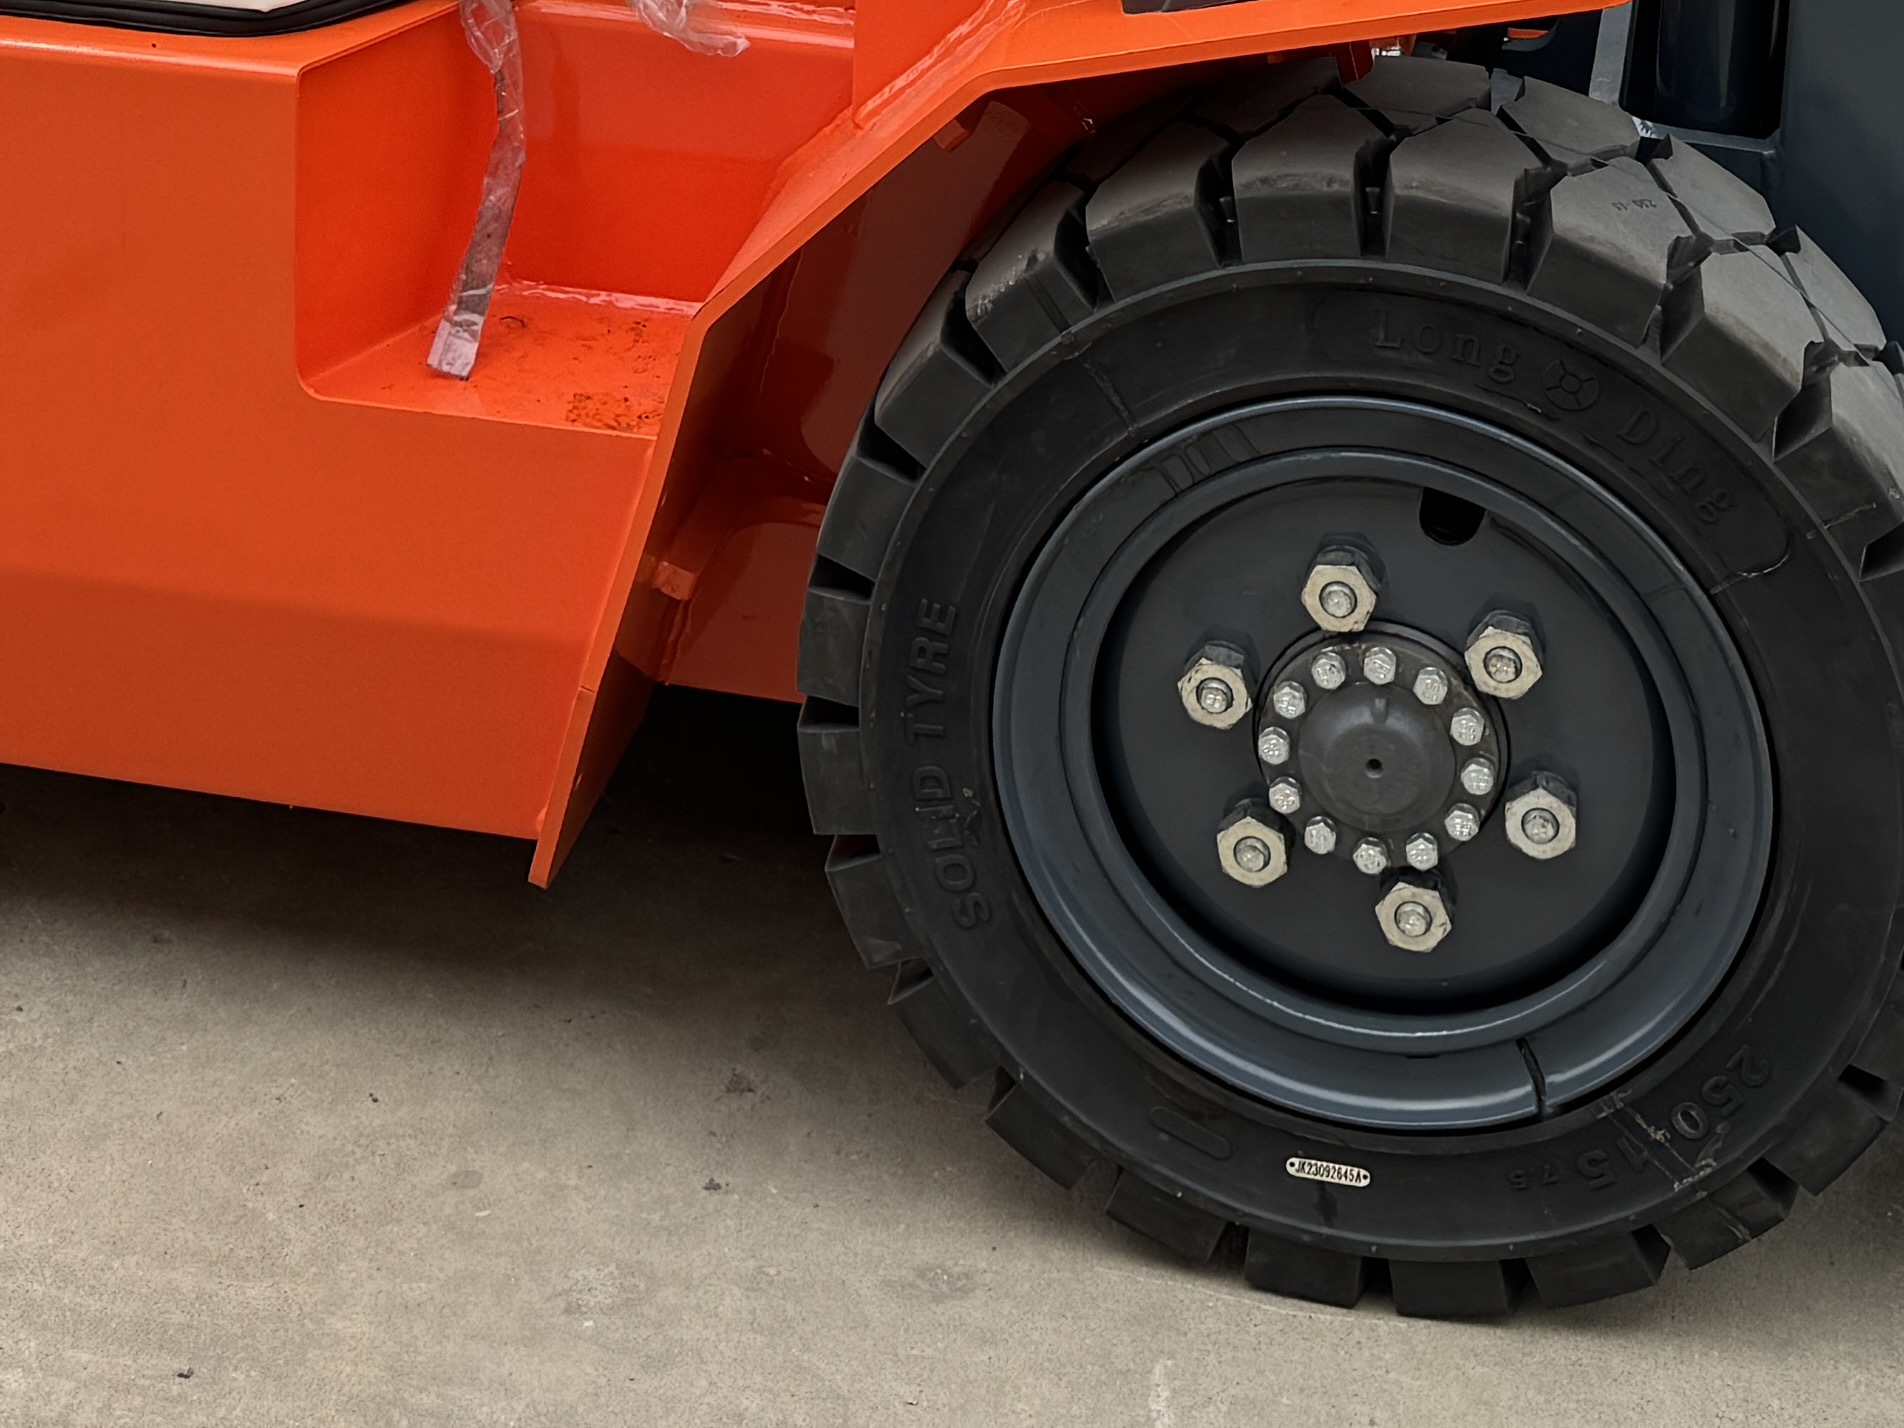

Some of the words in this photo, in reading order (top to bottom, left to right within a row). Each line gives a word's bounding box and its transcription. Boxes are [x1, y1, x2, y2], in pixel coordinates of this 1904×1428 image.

[1371, 307, 1521, 385] Long
[1616, 403, 1738, 525] Ding
[904, 598, 957, 745] TYRE
[912, 765, 993, 931] SOLID
